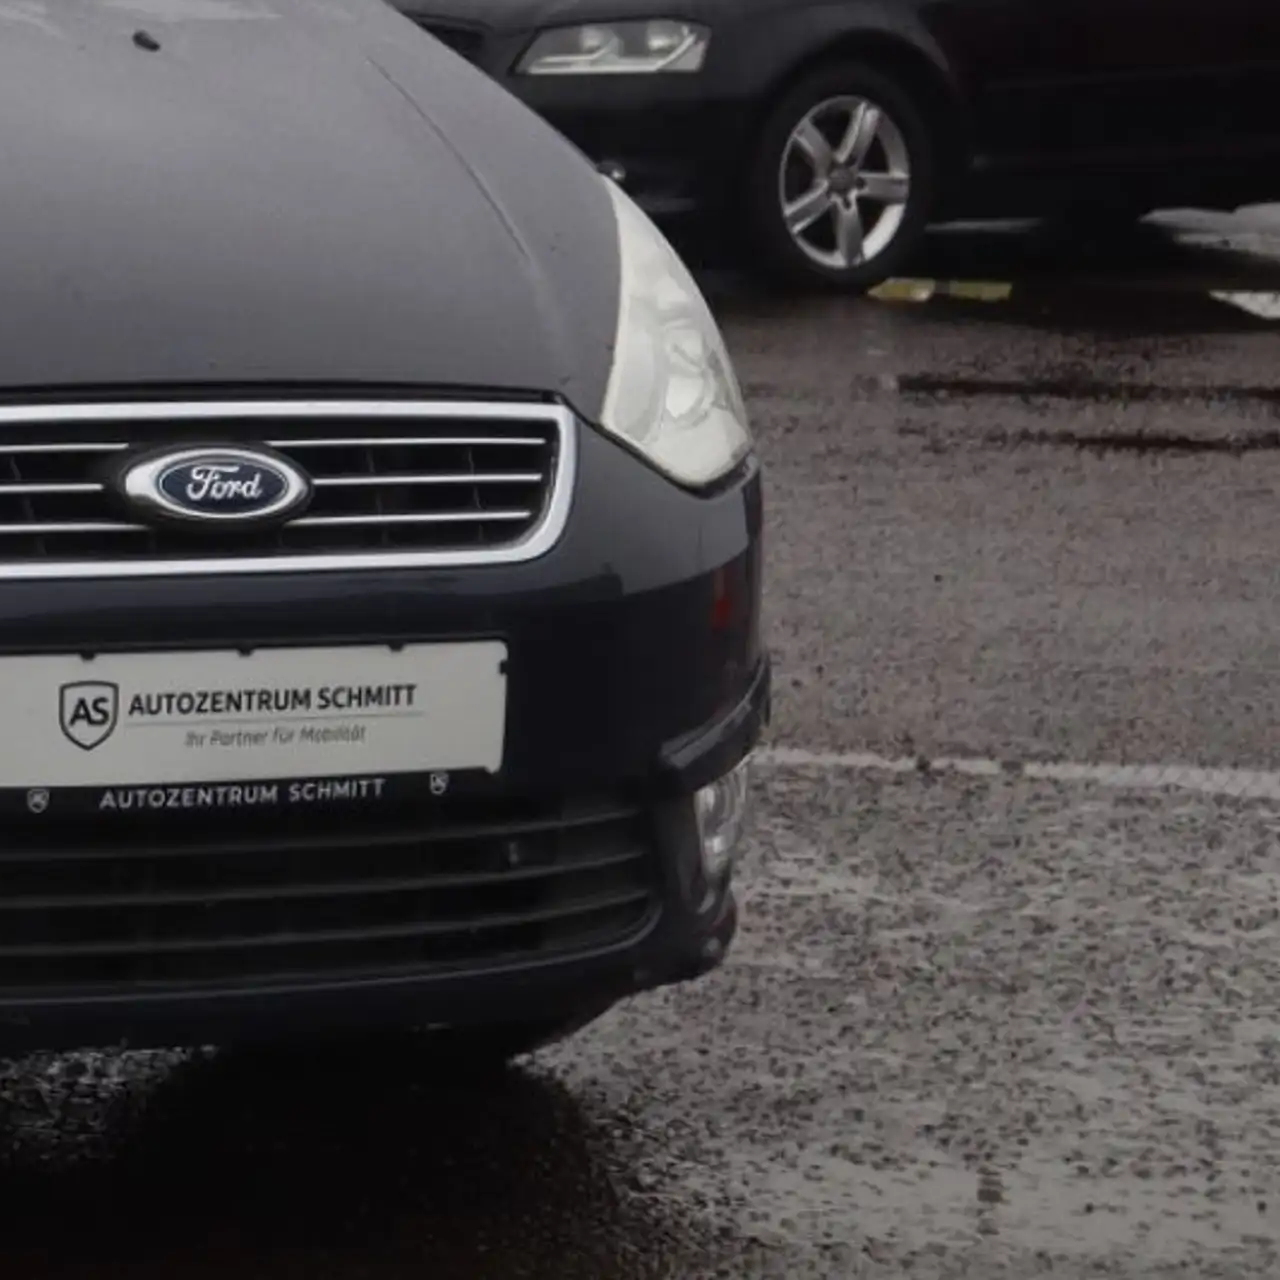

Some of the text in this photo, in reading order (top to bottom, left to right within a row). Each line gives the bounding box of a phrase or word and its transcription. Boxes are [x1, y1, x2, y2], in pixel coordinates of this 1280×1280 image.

[186, 464, 263, 501] Ford
[68, 697, 110, 726] AS
[127, 683, 418, 717] AUTOZENTRUM SCHMITT
[209, 728, 268, 748] Partner
[271, 725, 294, 745] für
[299, 724, 367, 745] Mobilität
[98, 777, 387, 810] AUTOZENTRUM SCHMITT
